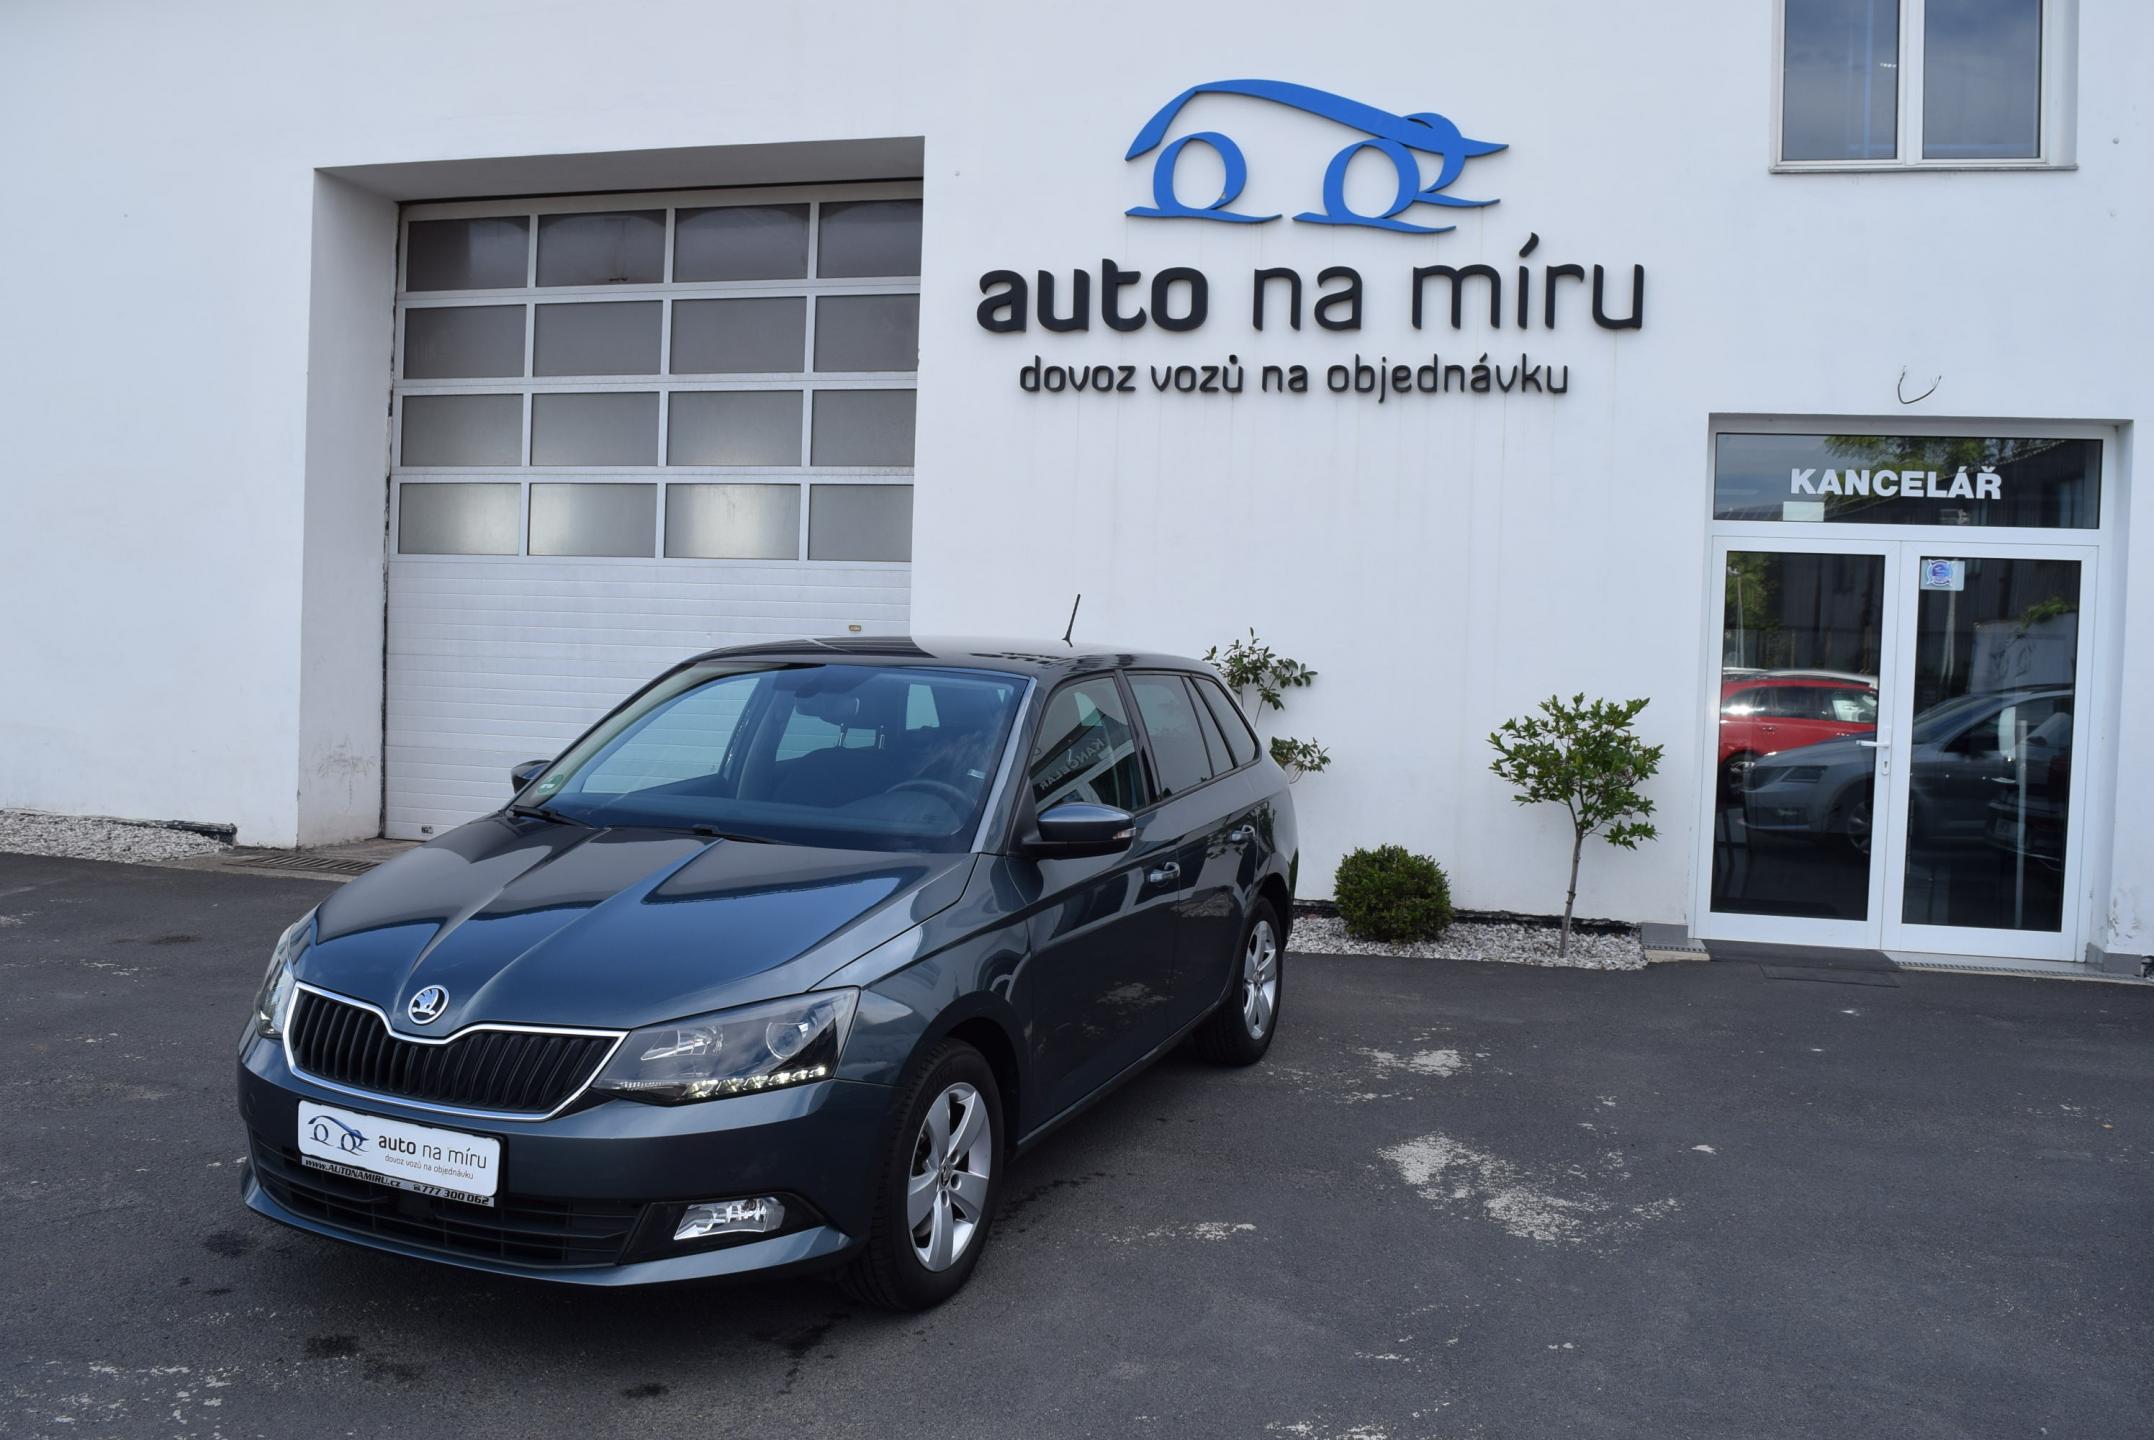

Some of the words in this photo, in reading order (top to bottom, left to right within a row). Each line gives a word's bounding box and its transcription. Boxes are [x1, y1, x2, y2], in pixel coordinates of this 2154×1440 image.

[976, 258, 1209, 334] auto
[1252, 265, 1363, 333] na
[1411, 232, 1645, 333] míru
[1019, 354, 1137, 394] dovoz
[1150, 354, 1244, 395] vozů
[1261, 364, 1309, 394] na
[1326, 353, 1569, 404] objednávku
[1790, 465, 2002, 500] KANCELÁŘ
[378, 1135, 416, 1155] auto
[422, 1144, 442, 1161] na
[448, 1147, 487, 1169] míru
[385, 1154, 404, 1165] dovoz
[423, 1163, 432, 1171] na
[433, 1165, 474, 1180] objednávku
[422, 1185, 442, 1197] 777
[442, 1190, 465, 1201] 300
